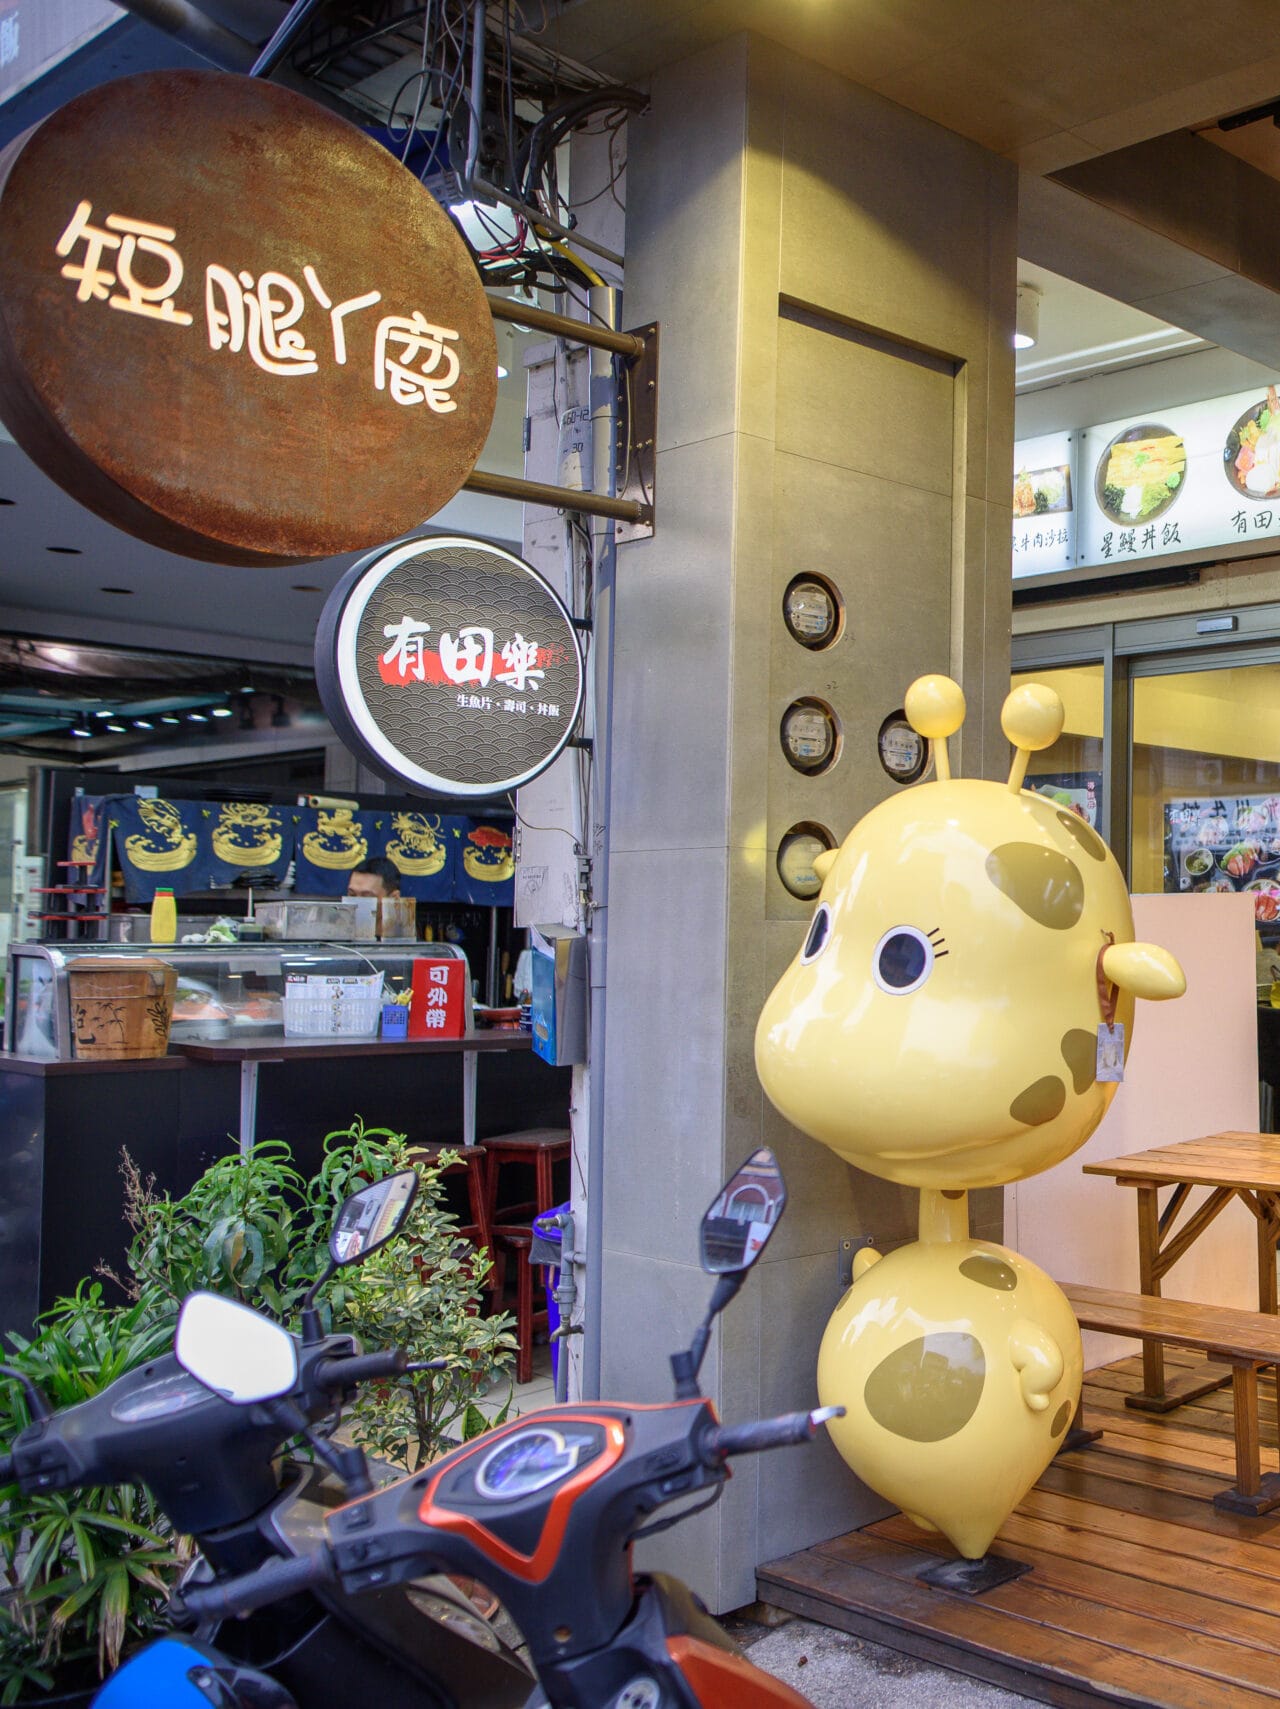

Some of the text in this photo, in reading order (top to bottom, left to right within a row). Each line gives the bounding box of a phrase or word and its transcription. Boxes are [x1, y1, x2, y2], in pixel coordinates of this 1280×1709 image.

[383, 615, 545, 691] 有田樂
[425, 965, 450, 1029] 可外帶
